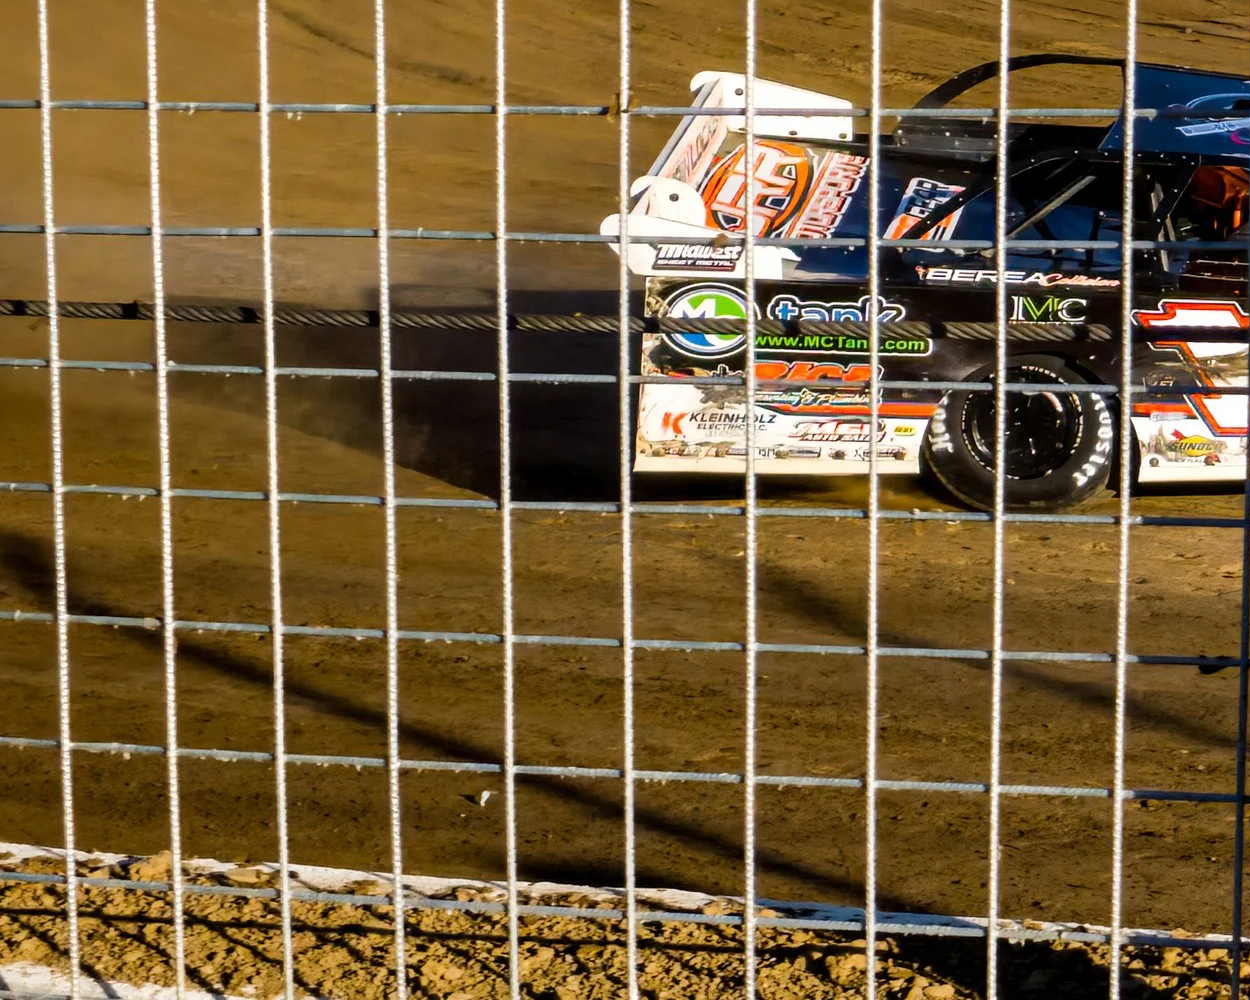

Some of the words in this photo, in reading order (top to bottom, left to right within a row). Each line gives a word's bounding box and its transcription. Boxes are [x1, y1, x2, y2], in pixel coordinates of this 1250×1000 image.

[658, 243, 743, 260] Midwest
[925, 268, 1043, 284] BEREA
[754, 335, 927, 352] www.MCTan.com
